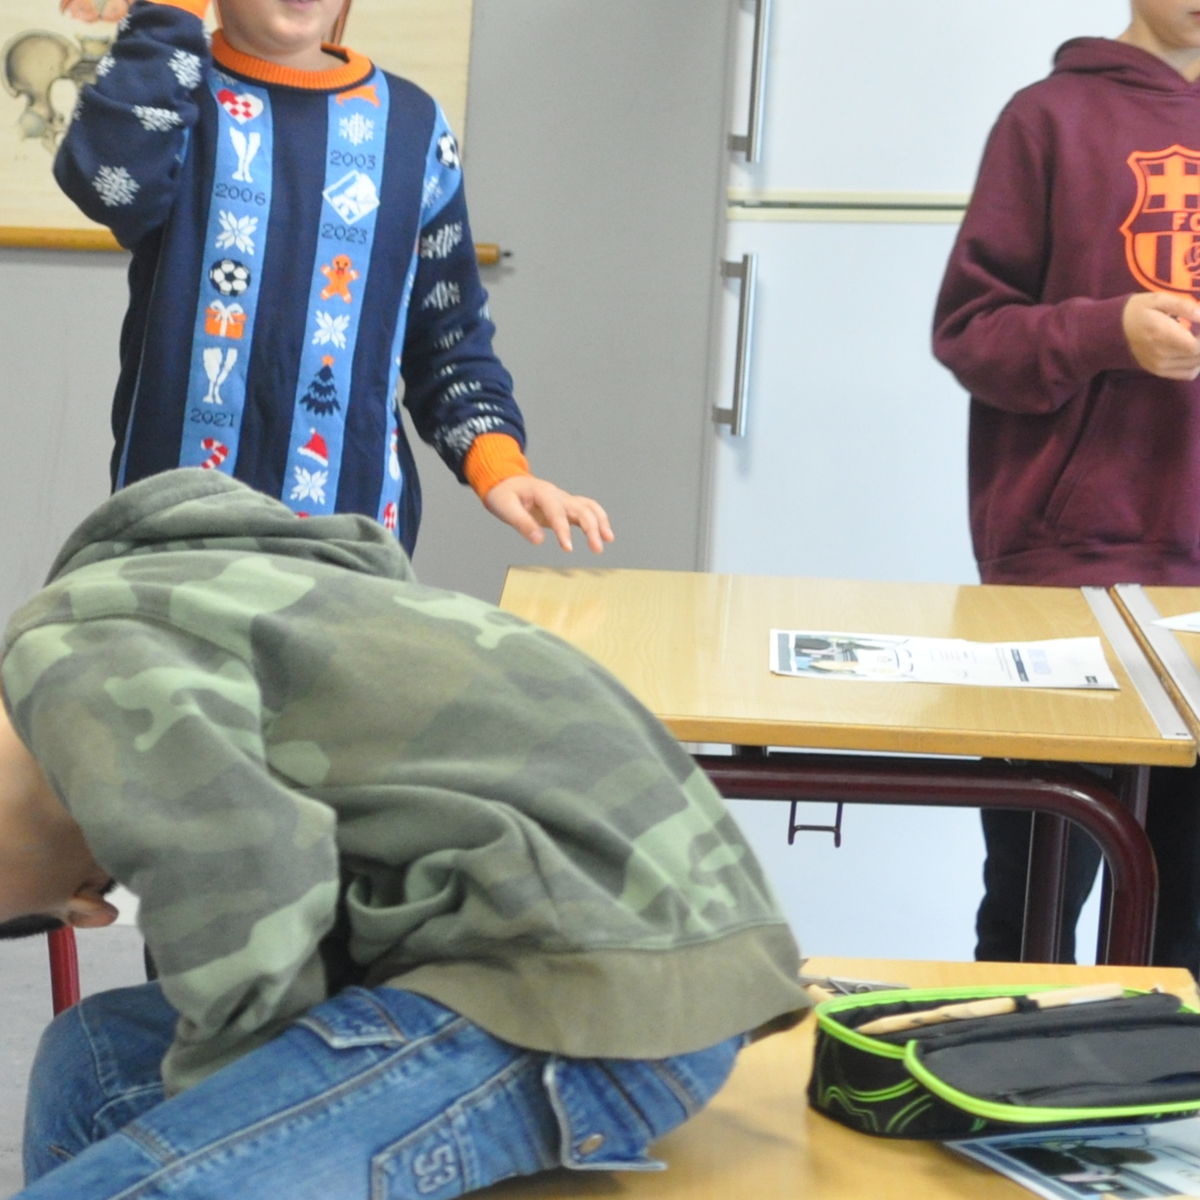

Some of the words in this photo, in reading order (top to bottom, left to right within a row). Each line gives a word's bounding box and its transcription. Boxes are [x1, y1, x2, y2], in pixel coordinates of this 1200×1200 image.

[329, 149, 376, 171] 2003
[215, 183, 266, 206] 2006
[321, 223, 368, 245] 2023
[190, 407, 235, 428] 2021
